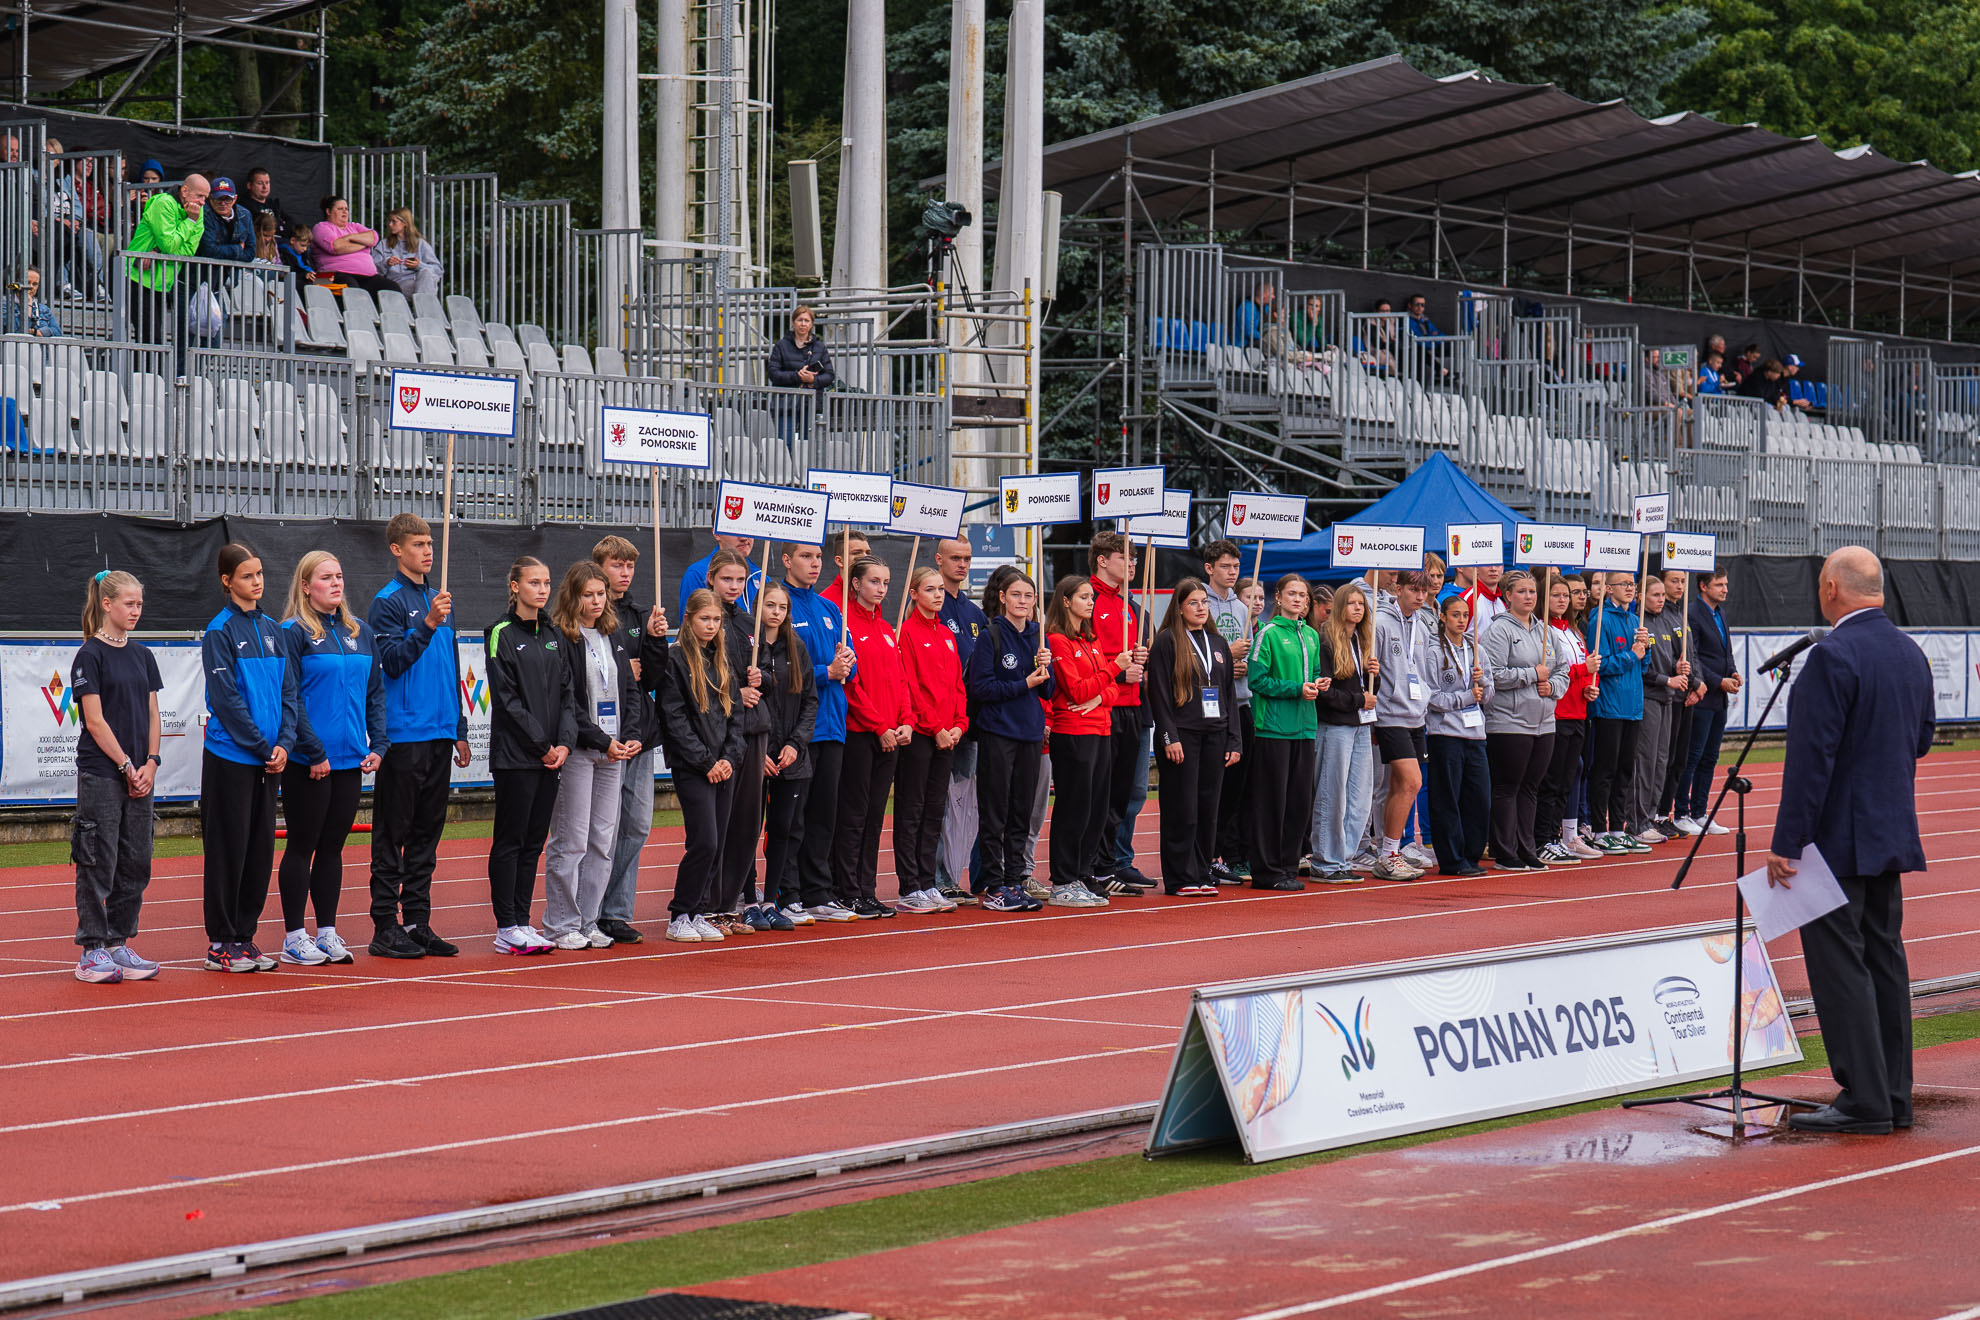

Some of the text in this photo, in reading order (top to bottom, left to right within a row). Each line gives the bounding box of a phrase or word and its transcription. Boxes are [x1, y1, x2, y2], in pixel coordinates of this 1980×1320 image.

[424, 397, 511, 413] WIELKOPOLSKIE
[638, 426, 699, 439] ZACHODNIO-
[640, 438, 697, 451] POMORSKIE
[830, 490, 889, 503] ŚWIĘTOKRZYSKIE
[1119, 487, 1155, 497] PODLASKIE
[1028, 494, 1071, 505] POMORSKIE
[753, 501, 818, 516] WARMIŃSKO-
[919, 504, 948, 518] ŚLĄSKIE
[1161, 509, 1187, 519] PACKIE
[755, 513, 813, 528] MAZURSKIE
[1249, 512, 1300, 523] MAZOWIECKIE
[1360, 542, 1418, 553] MAŁOPOLSKIE
[1471, 538, 1493, 549] ŁÓDZKIE
[1544, 540, 1575, 550] LUBUSKIE
[1599, 546, 1631, 556] LUBELSKIE
[1677, 548, 1712, 557] DOLNOŚLĄSKIE
[37, 746, 66, 754] OLIMPIADA
[37, 756, 43, 764] W
[43, 755, 72, 763] SPORTACH
[39, 769, 78, 777] WIELKOPOLSK
[1664, 1006, 1704, 1025] Continental
[1413, 992, 1635, 1076] POZNAŃ 2025
[1671, 1023, 1706, 1040] Tour Silver
